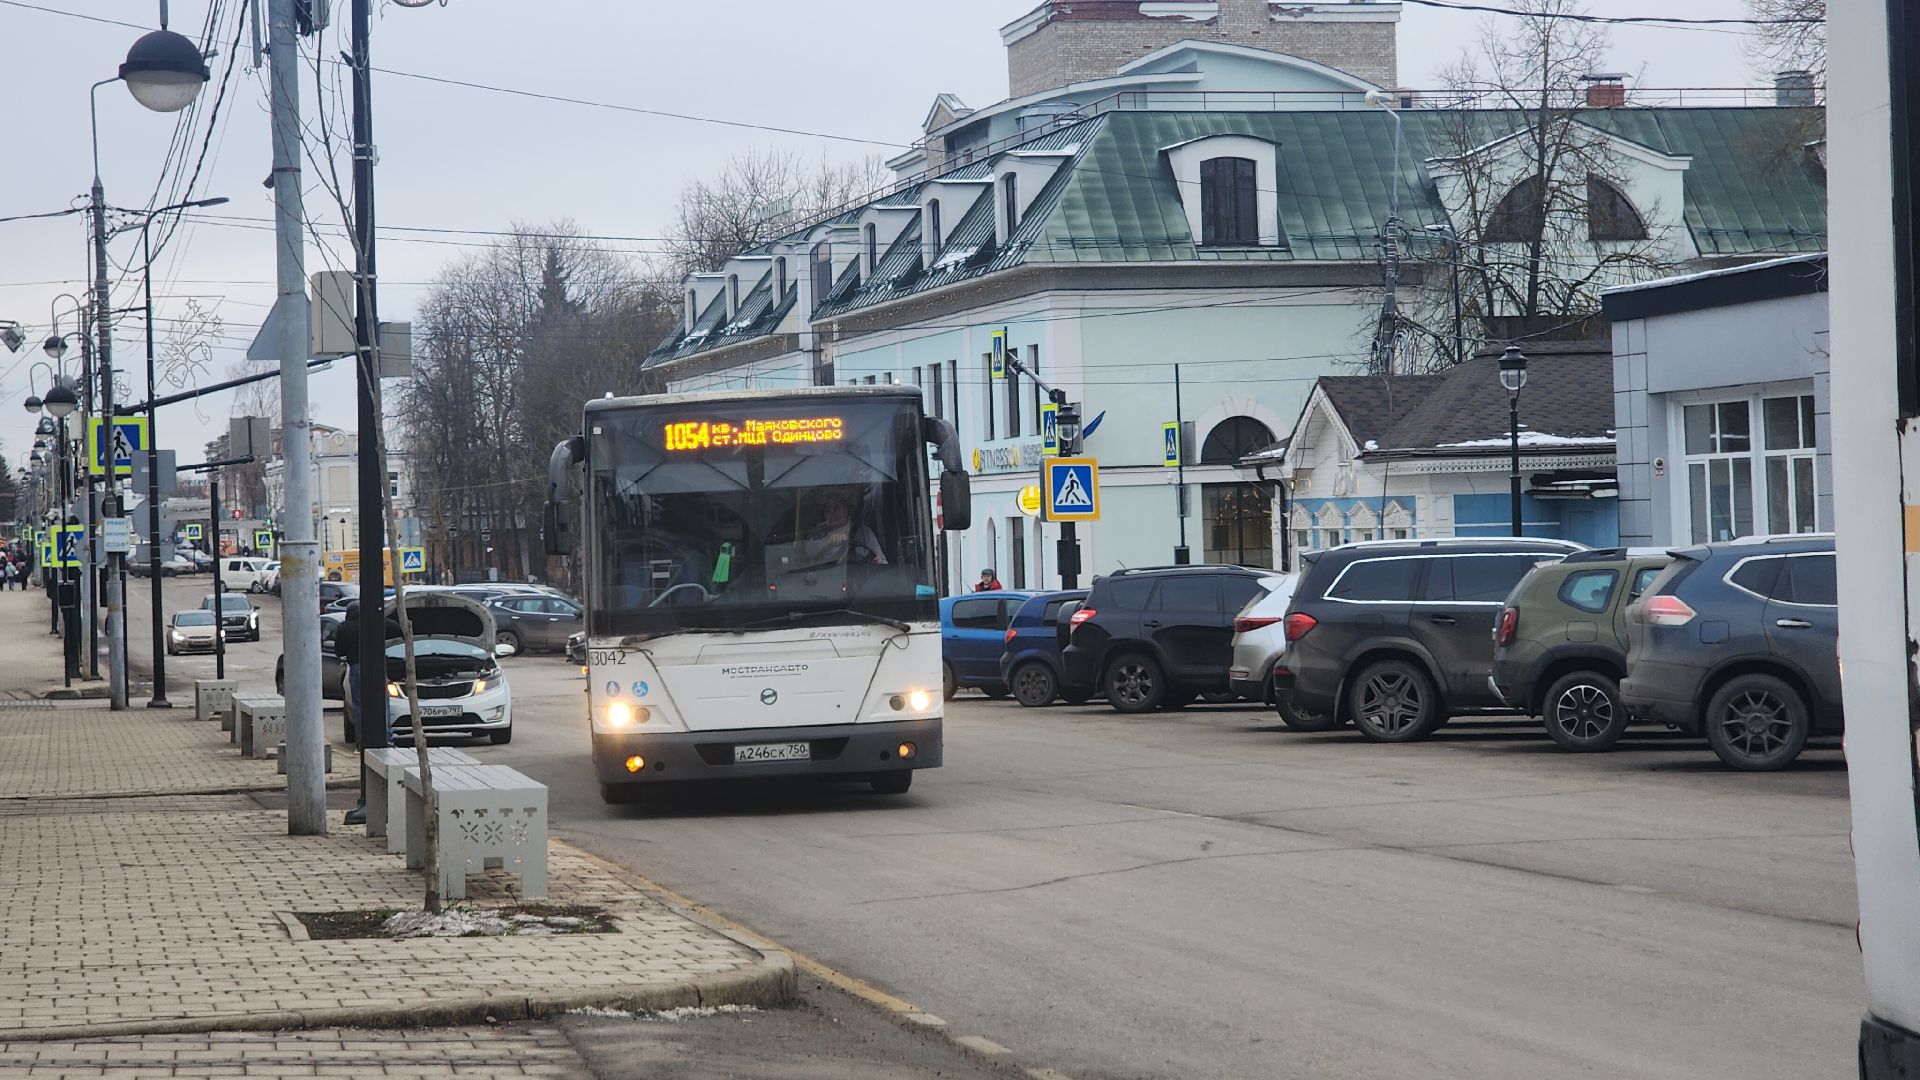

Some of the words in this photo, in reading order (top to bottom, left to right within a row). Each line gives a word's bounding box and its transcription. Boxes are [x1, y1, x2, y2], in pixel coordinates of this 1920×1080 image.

[711, 424, 738, 434] кв.
[745, 418, 842, 432] Маяковского
[664, 422, 709, 450] 1054
[772, 428, 843, 444] Одинцово
[722, 664, 809, 674] МОСТРАНСАВТО
[788, 744, 806, 754] 750
